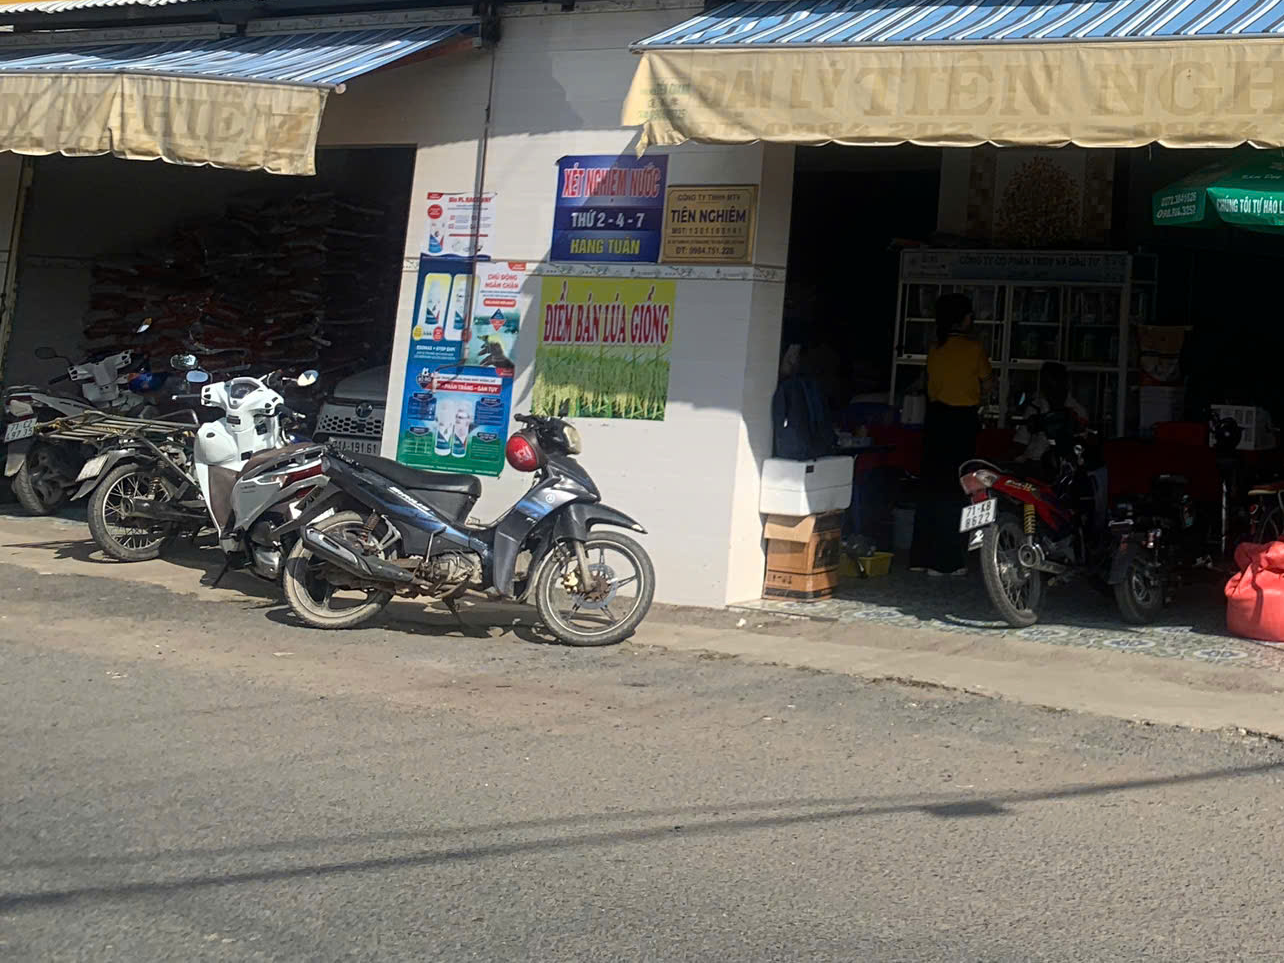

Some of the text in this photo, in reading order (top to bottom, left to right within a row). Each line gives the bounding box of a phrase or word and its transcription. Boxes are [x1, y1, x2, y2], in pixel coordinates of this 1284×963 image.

[1216, 195, 1238, 213] CHÚNG
[1239, 195, 1251, 213] TÔI
[571, 209, 645, 228] THỨ 2 4 7
[671, 205, 746, 223] TIÊN NGHIÊM
[575, 292, 601, 343] BÁN
